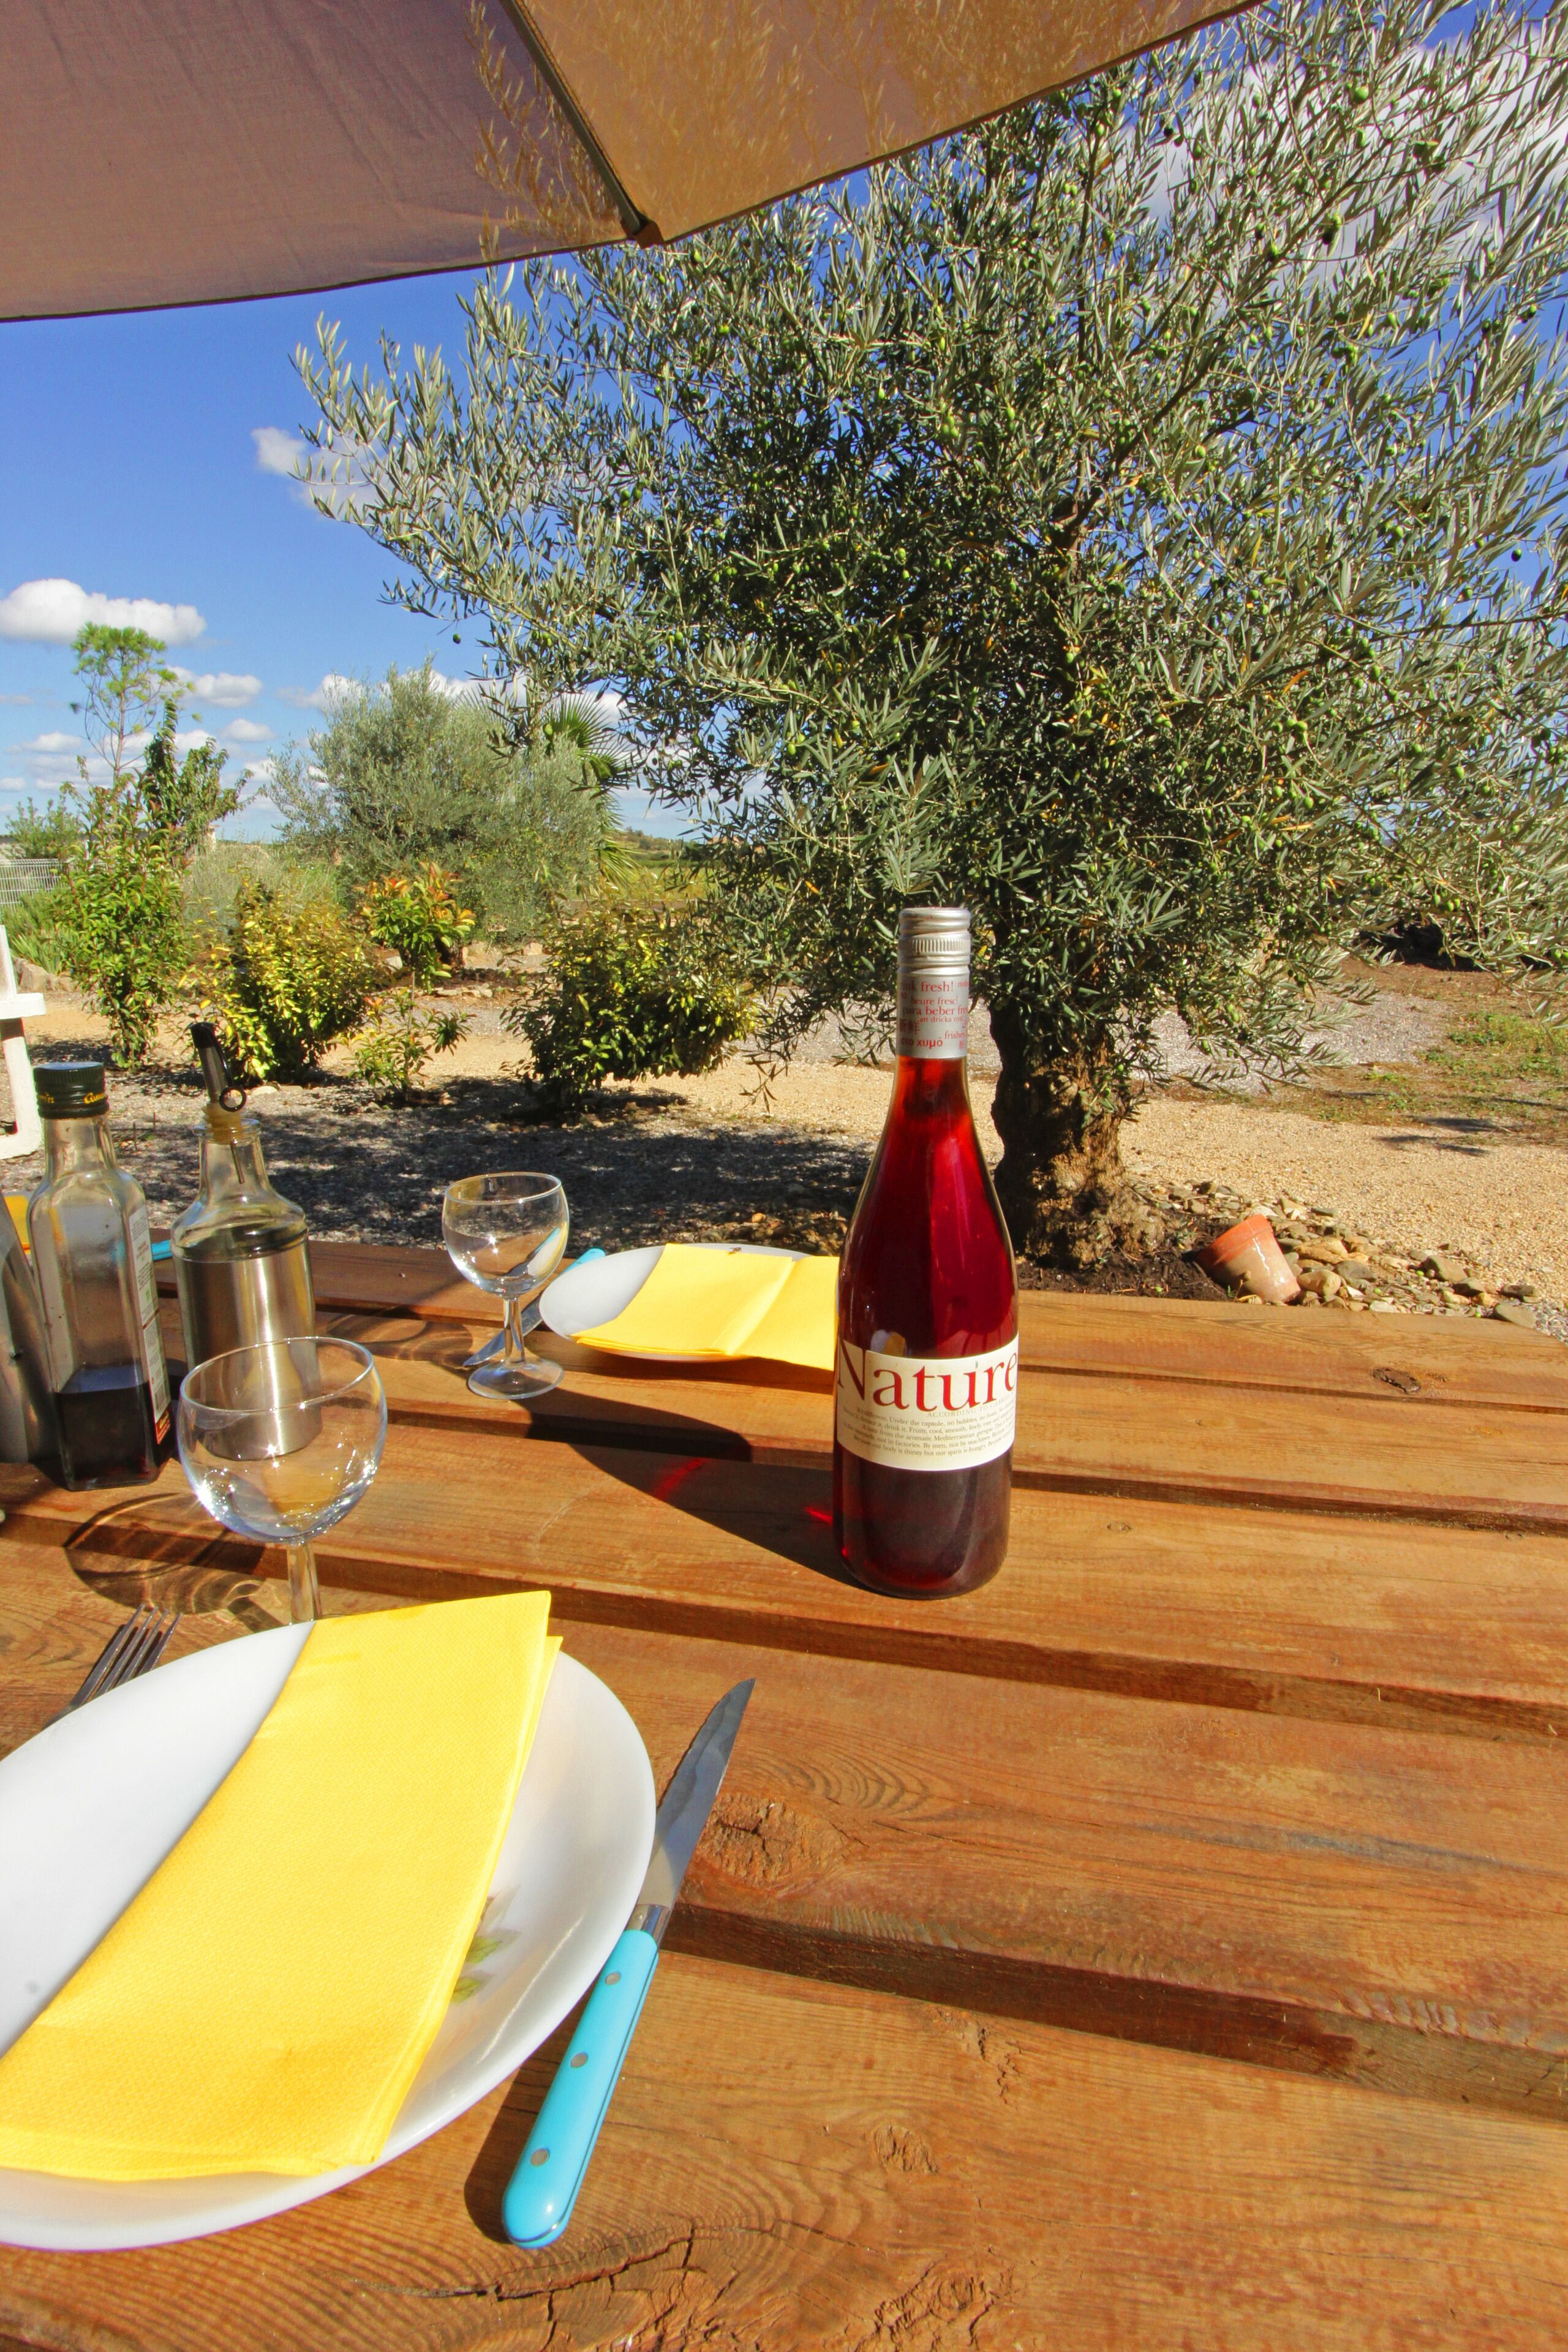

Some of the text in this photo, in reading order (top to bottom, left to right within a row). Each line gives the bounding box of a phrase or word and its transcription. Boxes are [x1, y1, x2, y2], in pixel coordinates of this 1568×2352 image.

[921, 981, 953, 991] fresh!
[925, 1005, 955, 1015] beber
[837, 1334, 1017, 1412] Nature
[927, 1409, 977, 1418] ACCORDING
[883, 1444, 897, 1453] body
